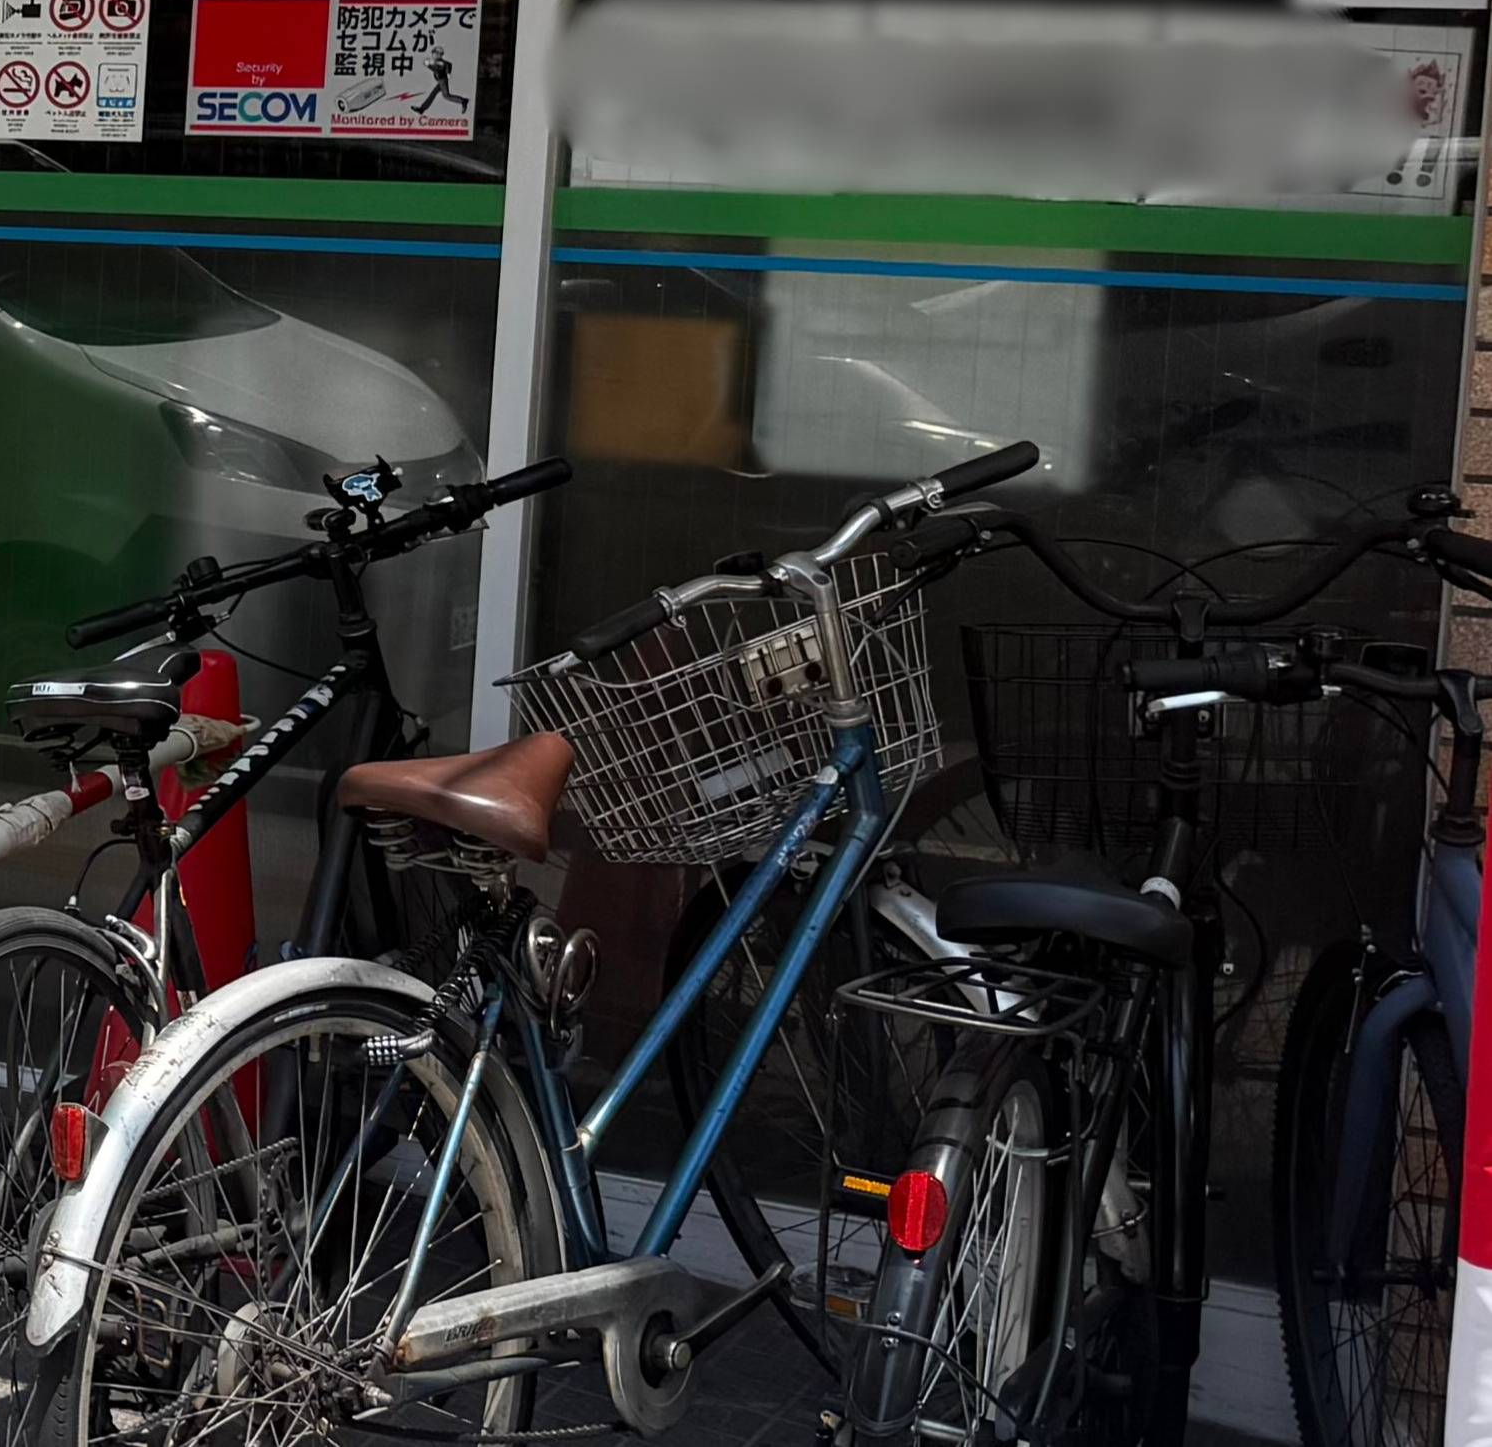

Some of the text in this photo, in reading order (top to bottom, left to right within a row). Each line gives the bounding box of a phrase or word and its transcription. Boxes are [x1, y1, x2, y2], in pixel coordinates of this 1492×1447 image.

[336, 6, 478, 30] 防犯カメラで
[335, 29, 436, 53] セコムが
[235, 61, 283, 74] Security
[333, 52, 414, 77] 監視中
[250, 72, 266, 87] by
[196, 92, 318, 123] SECOM
[330, 113, 469, 129] Monitored by Camera
